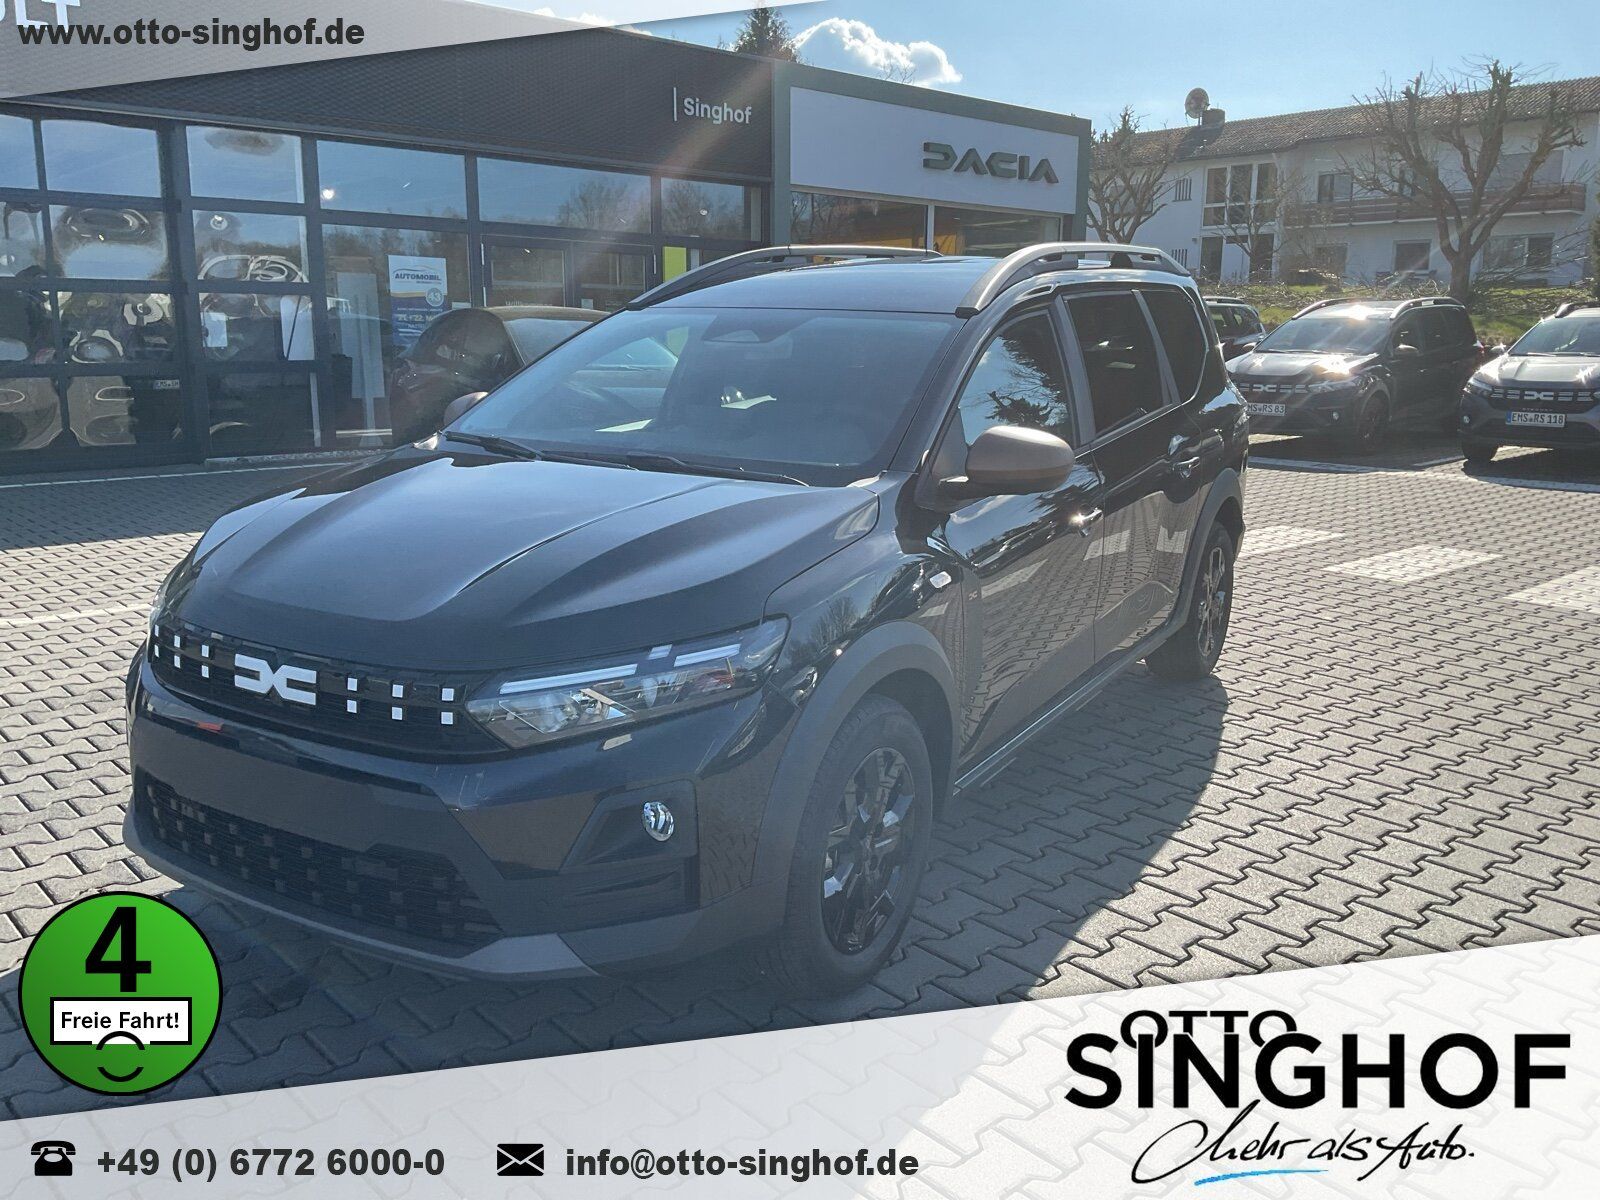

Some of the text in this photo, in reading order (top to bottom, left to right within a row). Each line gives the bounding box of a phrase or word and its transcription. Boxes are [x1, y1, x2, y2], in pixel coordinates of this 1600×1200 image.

[0, 0, 80, 33] LT
[683, 97, 752, 125] Singhof
[922, 141, 1060, 184] DACIA
